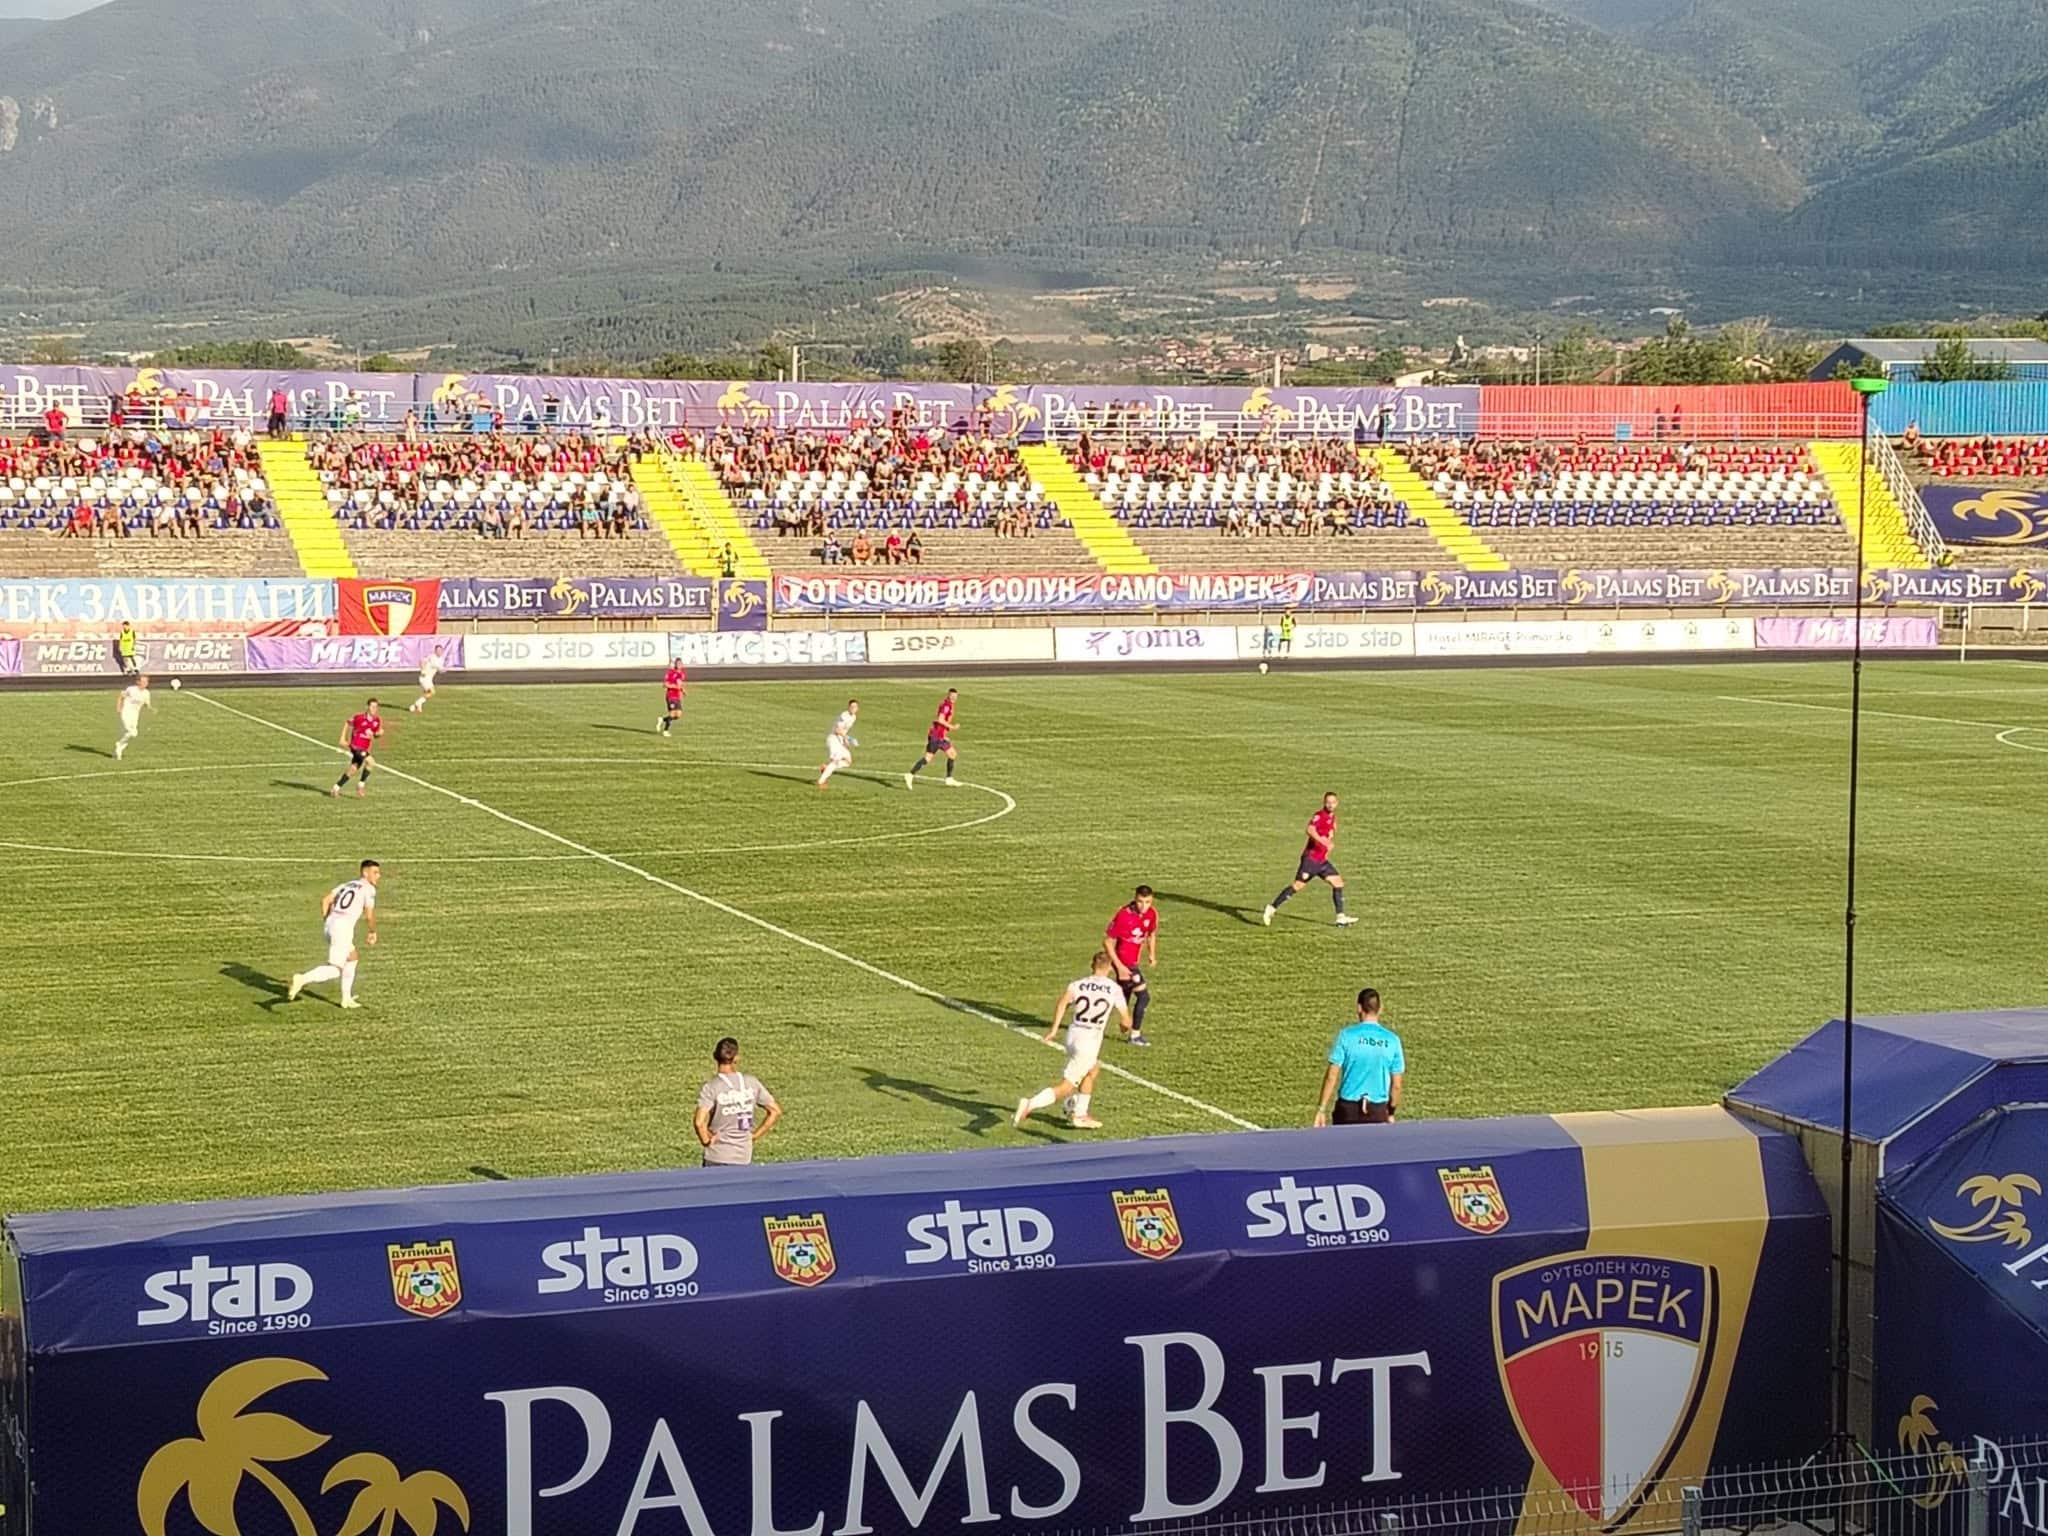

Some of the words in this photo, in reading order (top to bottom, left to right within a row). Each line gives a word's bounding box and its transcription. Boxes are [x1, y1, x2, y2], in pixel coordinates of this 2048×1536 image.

[368, 590, 412, 603] МАРЕК
[807, 578, 841, 604] ОТ
[852, 578, 939, 605] СОФИЯ
[946, 577, 984, 606] ДО
[989, 576, 1076, 604] СОЛУН
[1100, 574, 1174, 602] САМО
[0, 583, 69, 623] ЕК
[79, 583, 325, 622] ЗАВИНАГИ
[37, 641, 108, 662] MrBit
[164, 640, 233, 660] MrBit
[310, 637, 404, 664] MrBit
[891, 636, 956, 652] ЗОРА
[1075, 996, 1110, 1024] 22
[1306, 1232, 1346, 1248] Since
[1350, 1228, 1390, 1244] 1990
[391, 1247, 451, 1259] ДУПНИЦА
[967, 1257, 1011, 1274] Since
[1015, 1252, 1056, 1269] 1990
[1541, 1261, 1626, 1284] ФУТБОЛЕН
[1630, 1262, 1671, 1279] КЛУБ
[603, 1287, 649, 1304] Since
[653, 1281, 699, 1298] 1990
[1515, 1279, 1693, 1340] МАРЕК
[208, 1319, 257, 1336] Since
[262, 1313, 312, 1331] 1990
[484, 1383, 1081, 1536] PALMS
[1123, 1331, 1432, 1523] BET
